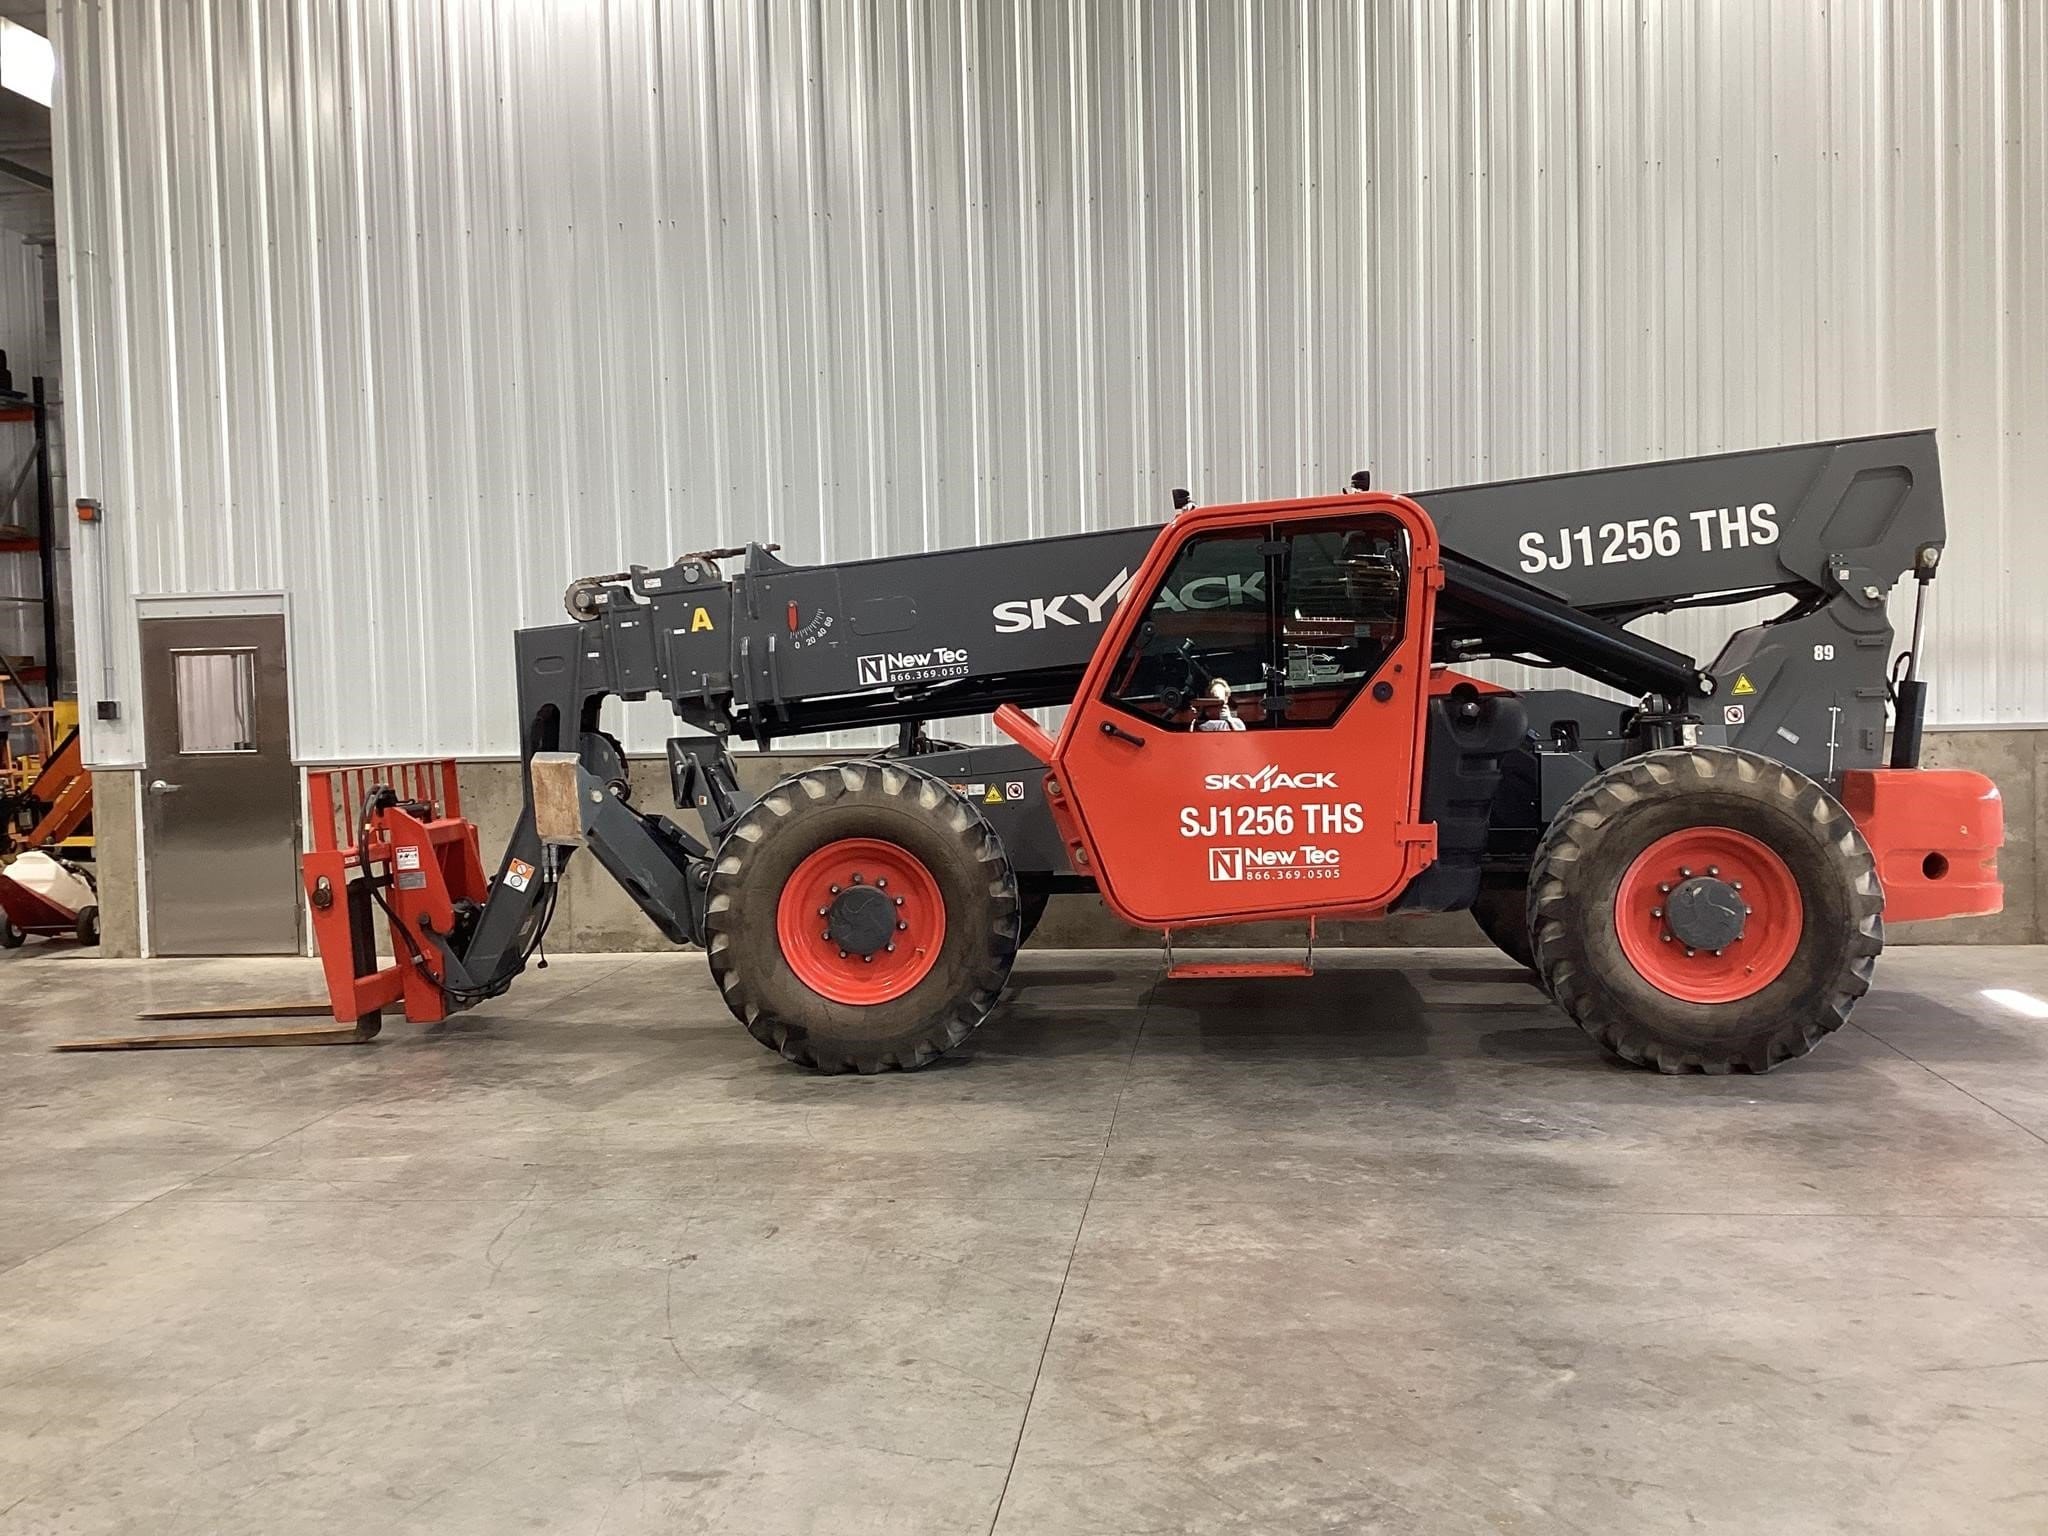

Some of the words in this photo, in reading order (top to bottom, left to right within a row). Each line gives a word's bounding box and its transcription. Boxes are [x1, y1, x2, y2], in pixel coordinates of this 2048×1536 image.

[1518, 515, 1681, 574] SJ1256
[1689, 502, 1780, 552] THS
[691, 607, 714, 632] A
[794, 641, 801, 649] 0
[805, 636, 817, 646] 20
[817, 627, 827, 638] 40
[824, 616, 834, 627] 60
[887, 652, 932, 669] New
[933, 647, 969, 664] Tec
[1813, 644, 1835, 661] 89
[890, 665, 969, 682] 866.369.0505
[1204, 764, 1339, 793] SKYJACK
[1180, 804, 1294, 838] SJ1256
[1301, 803, 1364, 834] THS
[1245, 847, 1297, 865] New
[1300, 846, 1340, 864] Tec
[1246, 869, 1340, 881] 866.369.0505
